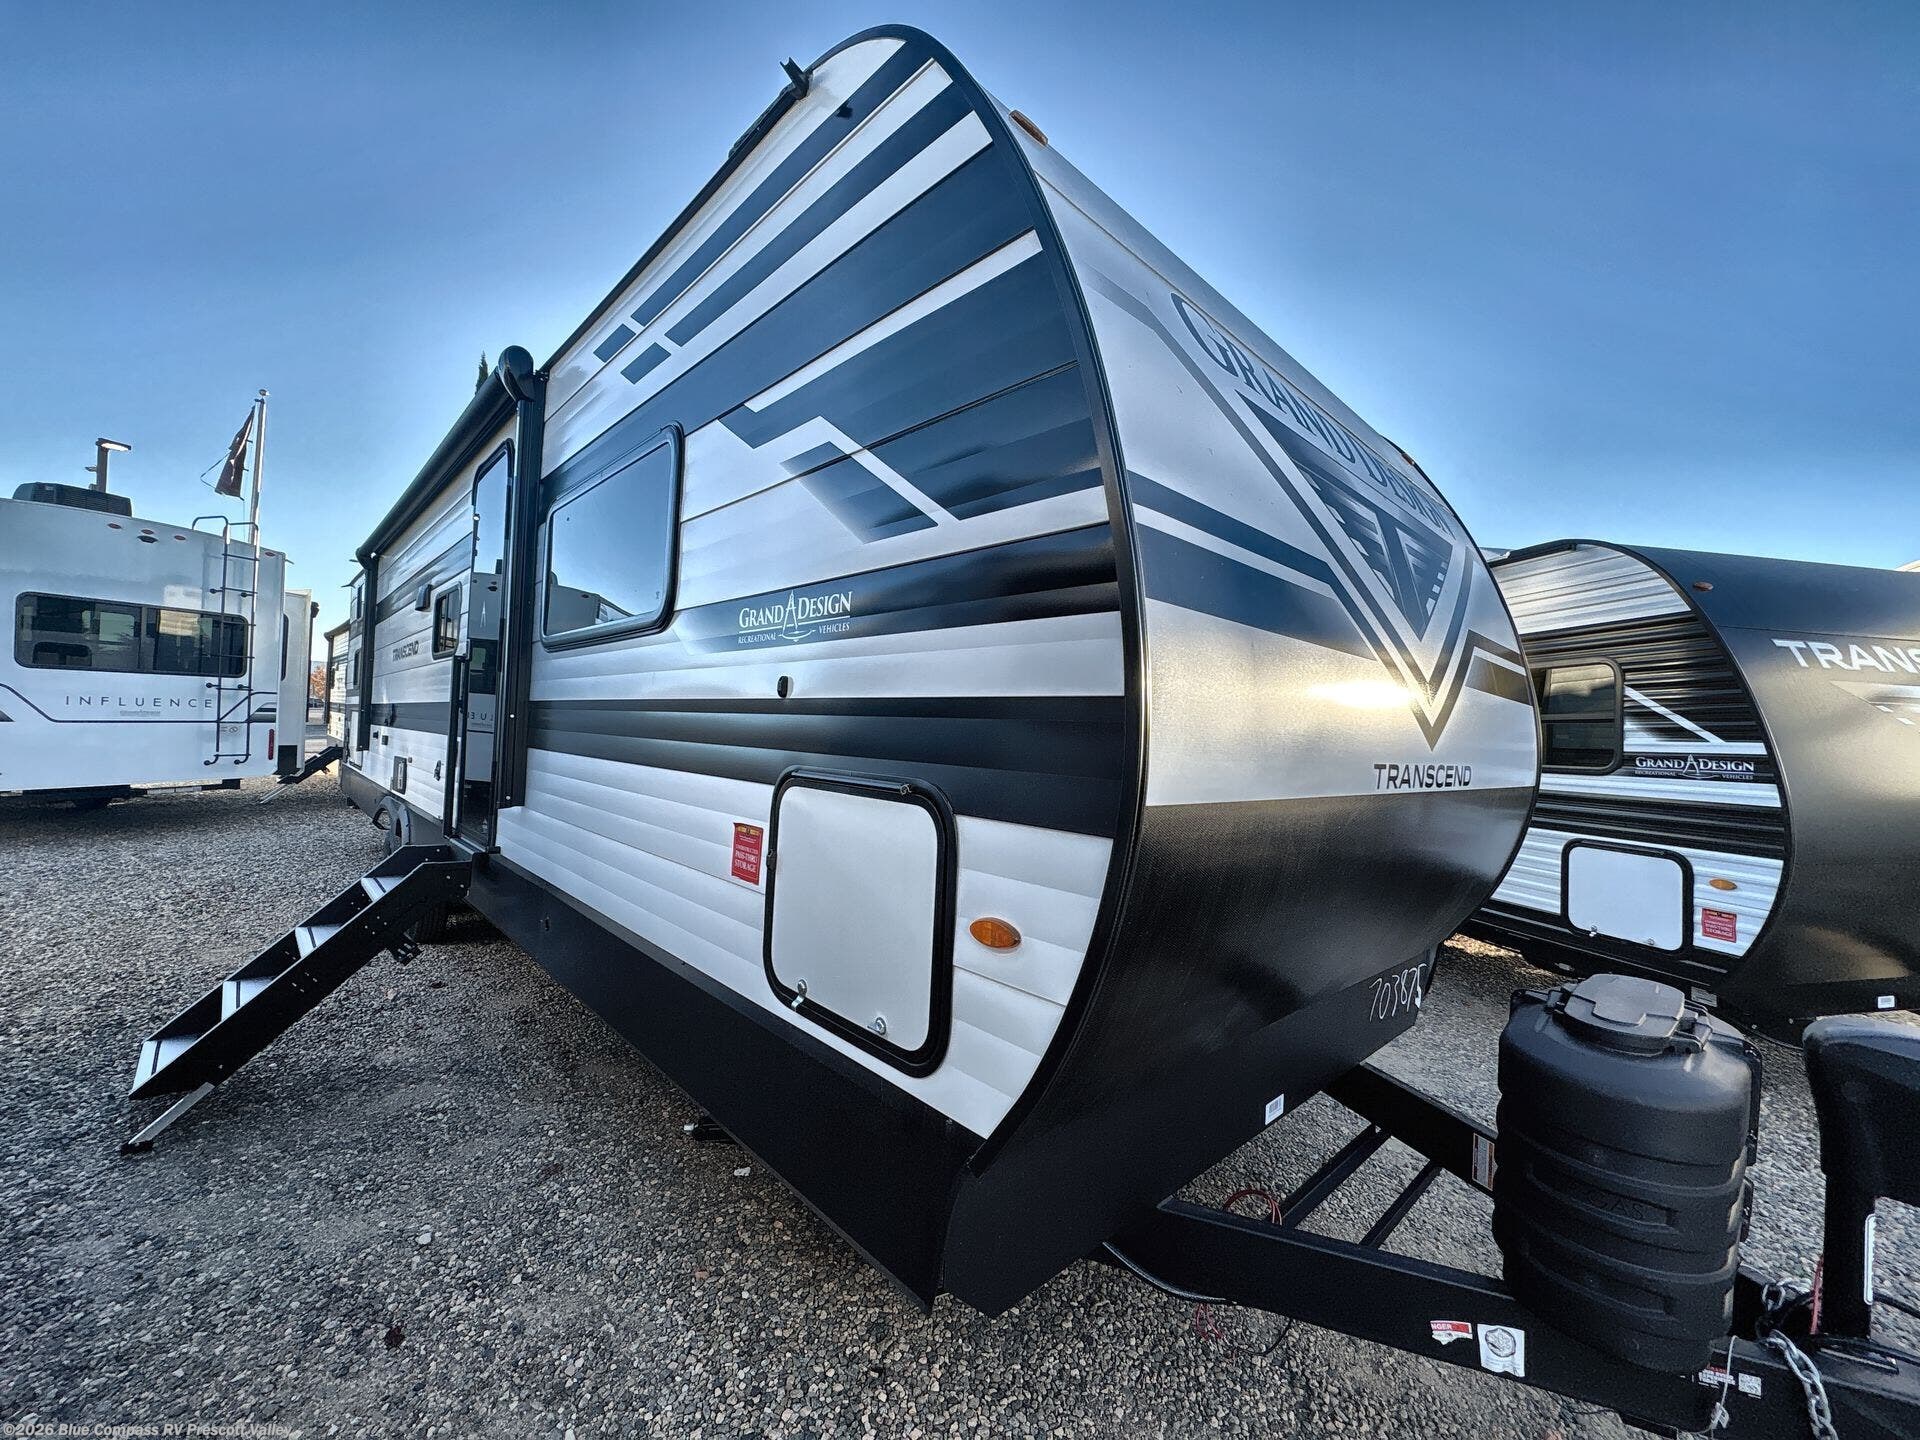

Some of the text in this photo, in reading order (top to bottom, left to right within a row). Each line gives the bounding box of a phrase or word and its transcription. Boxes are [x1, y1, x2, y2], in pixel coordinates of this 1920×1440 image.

[1170, 292, 1456, 540] GRAND DESIGN
[738, 591, 853, 628] GRAND DESIGN
[738, 622, 850, 644] RECREATIONAL VEHICLES
[65, 695, 213, 708] INFLUENCE
[1634, 769, 1676, 777] RECREATIONAL
[1635, 756, 1754, 771] GRAND DESIGN
[1373, 763, 1472, 790] TRANSCEND
[734, 858, 757, 873] STORAGE
[1368, 963, 1427, 1022] 703875
